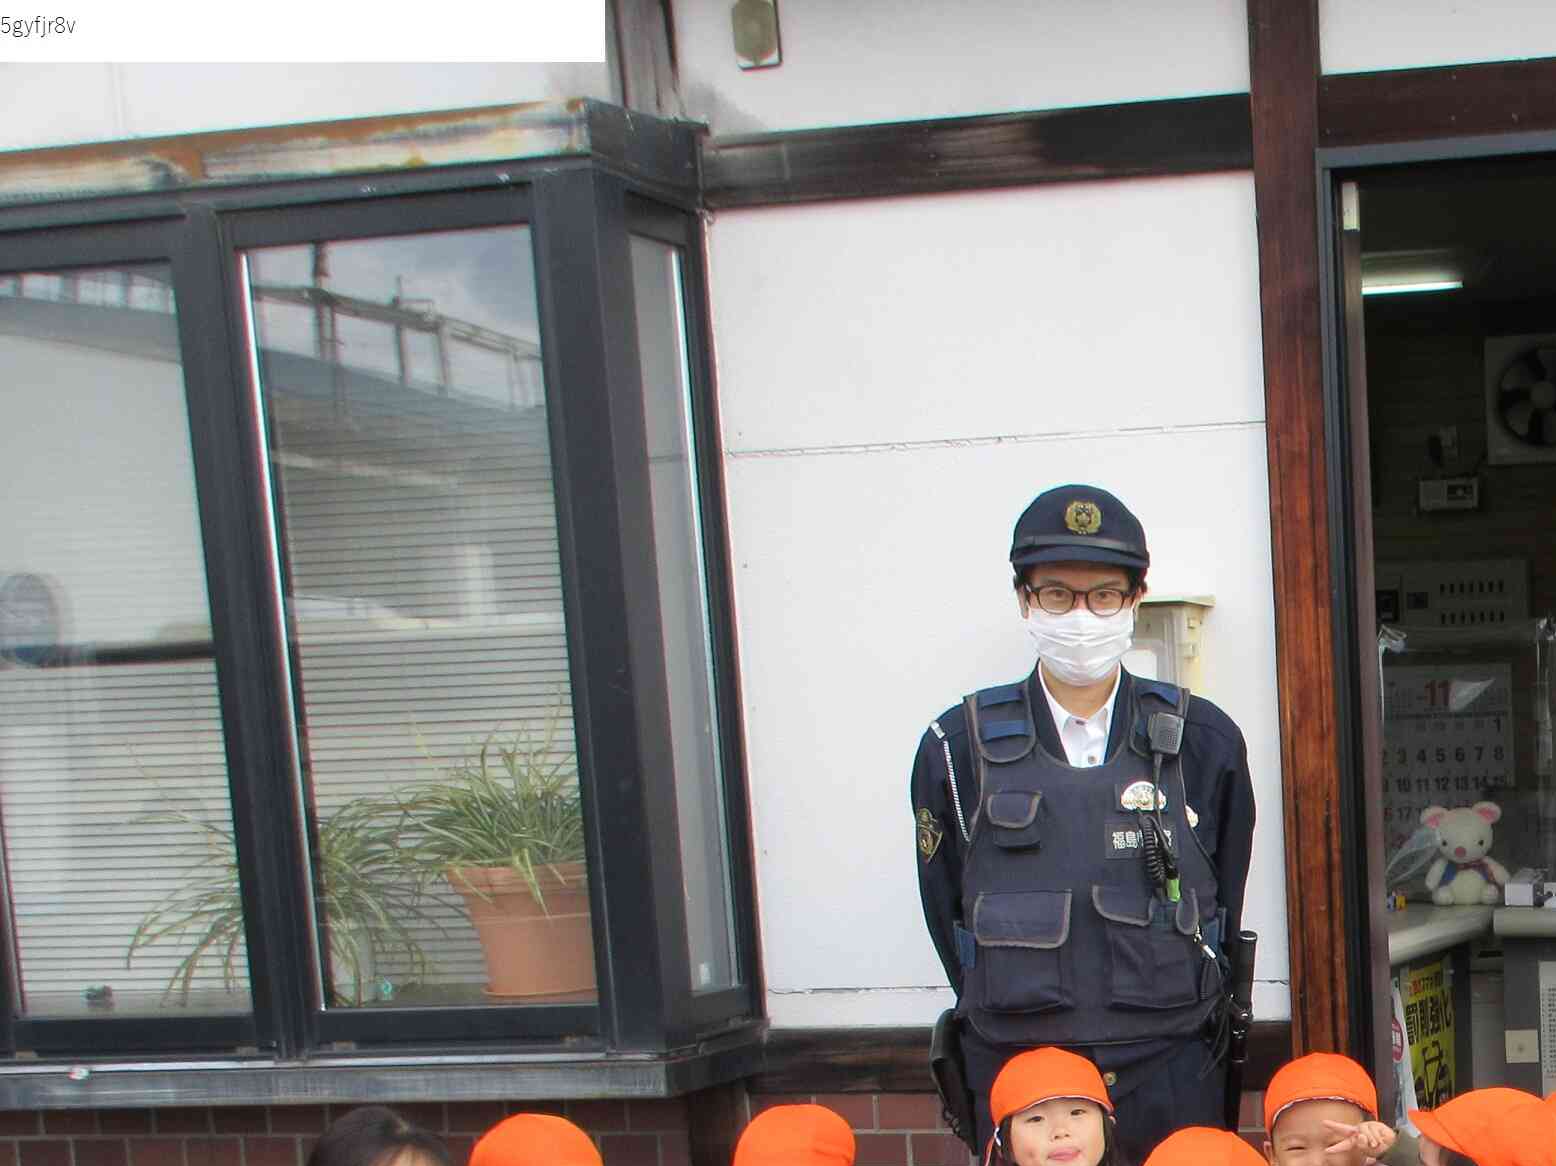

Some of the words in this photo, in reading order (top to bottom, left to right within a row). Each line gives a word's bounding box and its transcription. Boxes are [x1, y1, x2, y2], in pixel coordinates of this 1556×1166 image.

[1416, 748, 1427, 764] 4
[1435, 747, 1446, 763] 5
[1455, 747, 1466, 762] 6
[1474, 746, 1484, 762] 7
[1493, 746, 1505, 761] 8
[1416, 777, 1430, 792] 11
[1435, 775, 1450, 792] 12
[1454, 775, 1470, 791] 13
